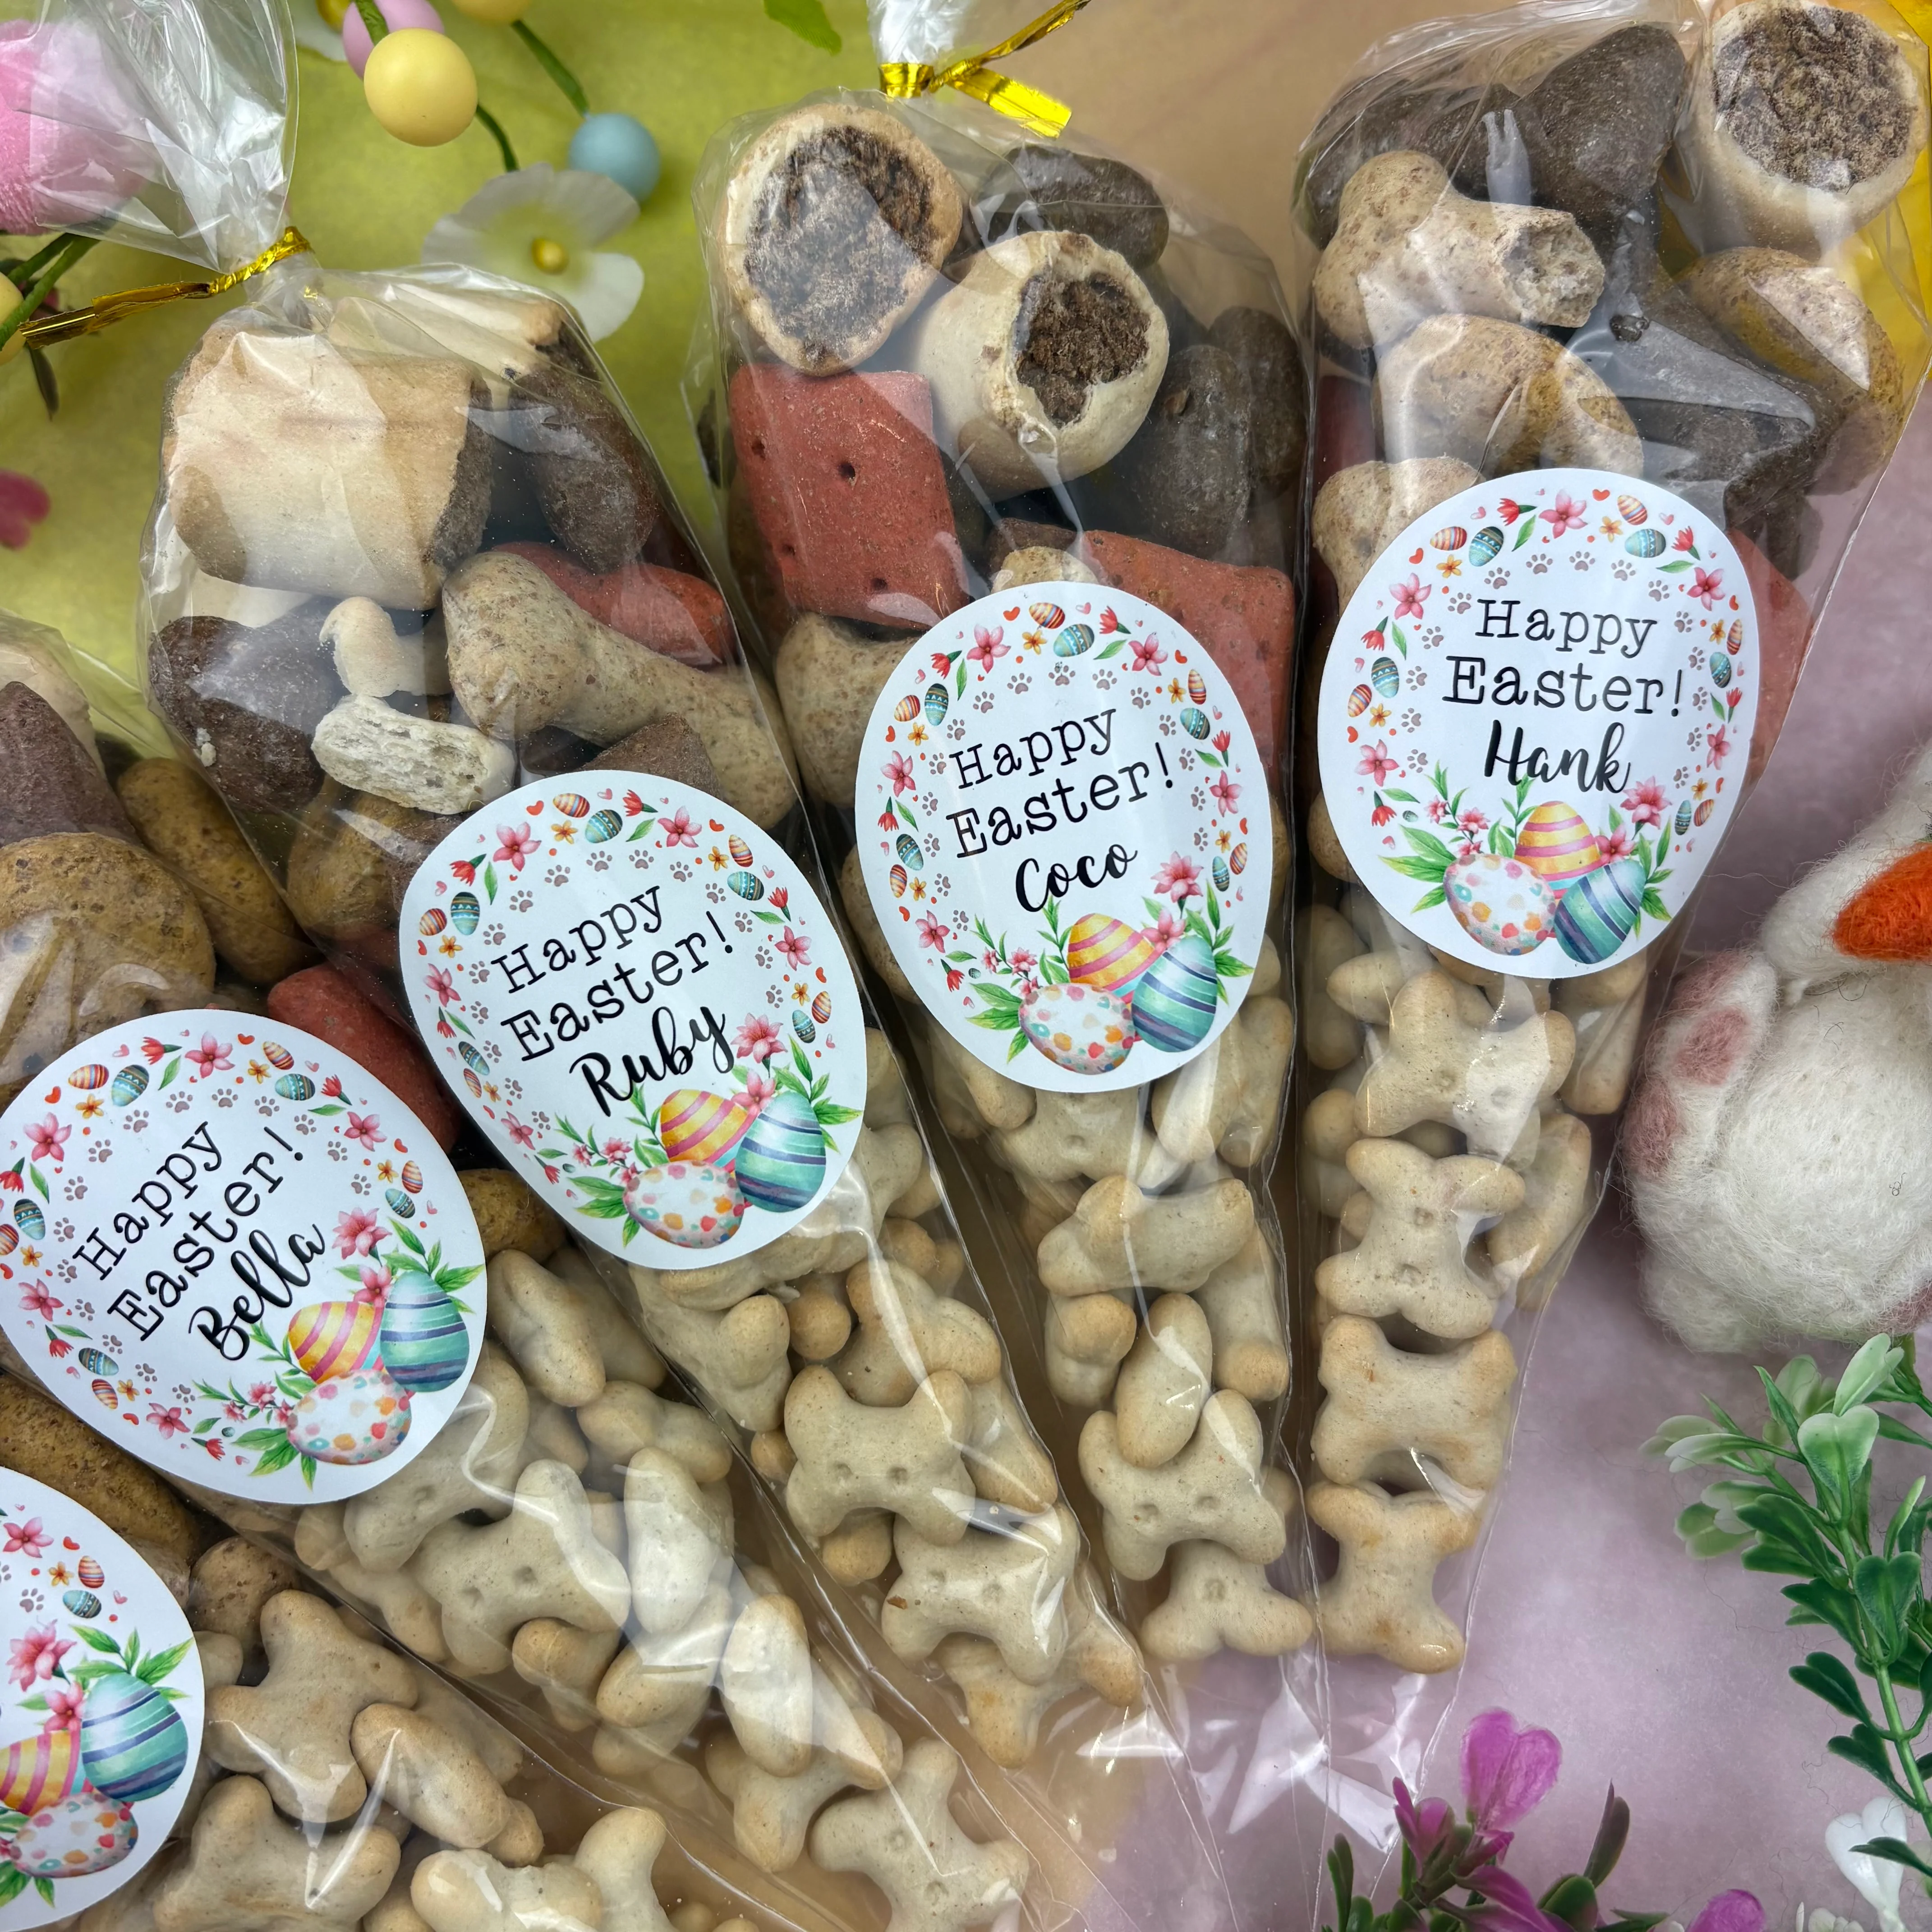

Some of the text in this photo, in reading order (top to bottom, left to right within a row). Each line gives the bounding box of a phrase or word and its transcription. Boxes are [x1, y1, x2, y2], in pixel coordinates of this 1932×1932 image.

[1475, 599, 1658, 658] Happy
[1442, 655, 1683, 717] Easter!
[945, 742, 1173, 858] Easter!
[948, 708, 1116, 789] Happy
[1484, 719, 1631, 793] Hank
[1015, 844, 1137, 912] Coco
[490, 885, 662, 994] Happy
[500, 911, 733, 1062] Easter!
[569, 1006, 734, 1117] Ruby
[72, 1121, 222, 1280] Happy
[107, 1127, 303, 1341] Easter!
[188, 1224, 325, 1361] Bella
